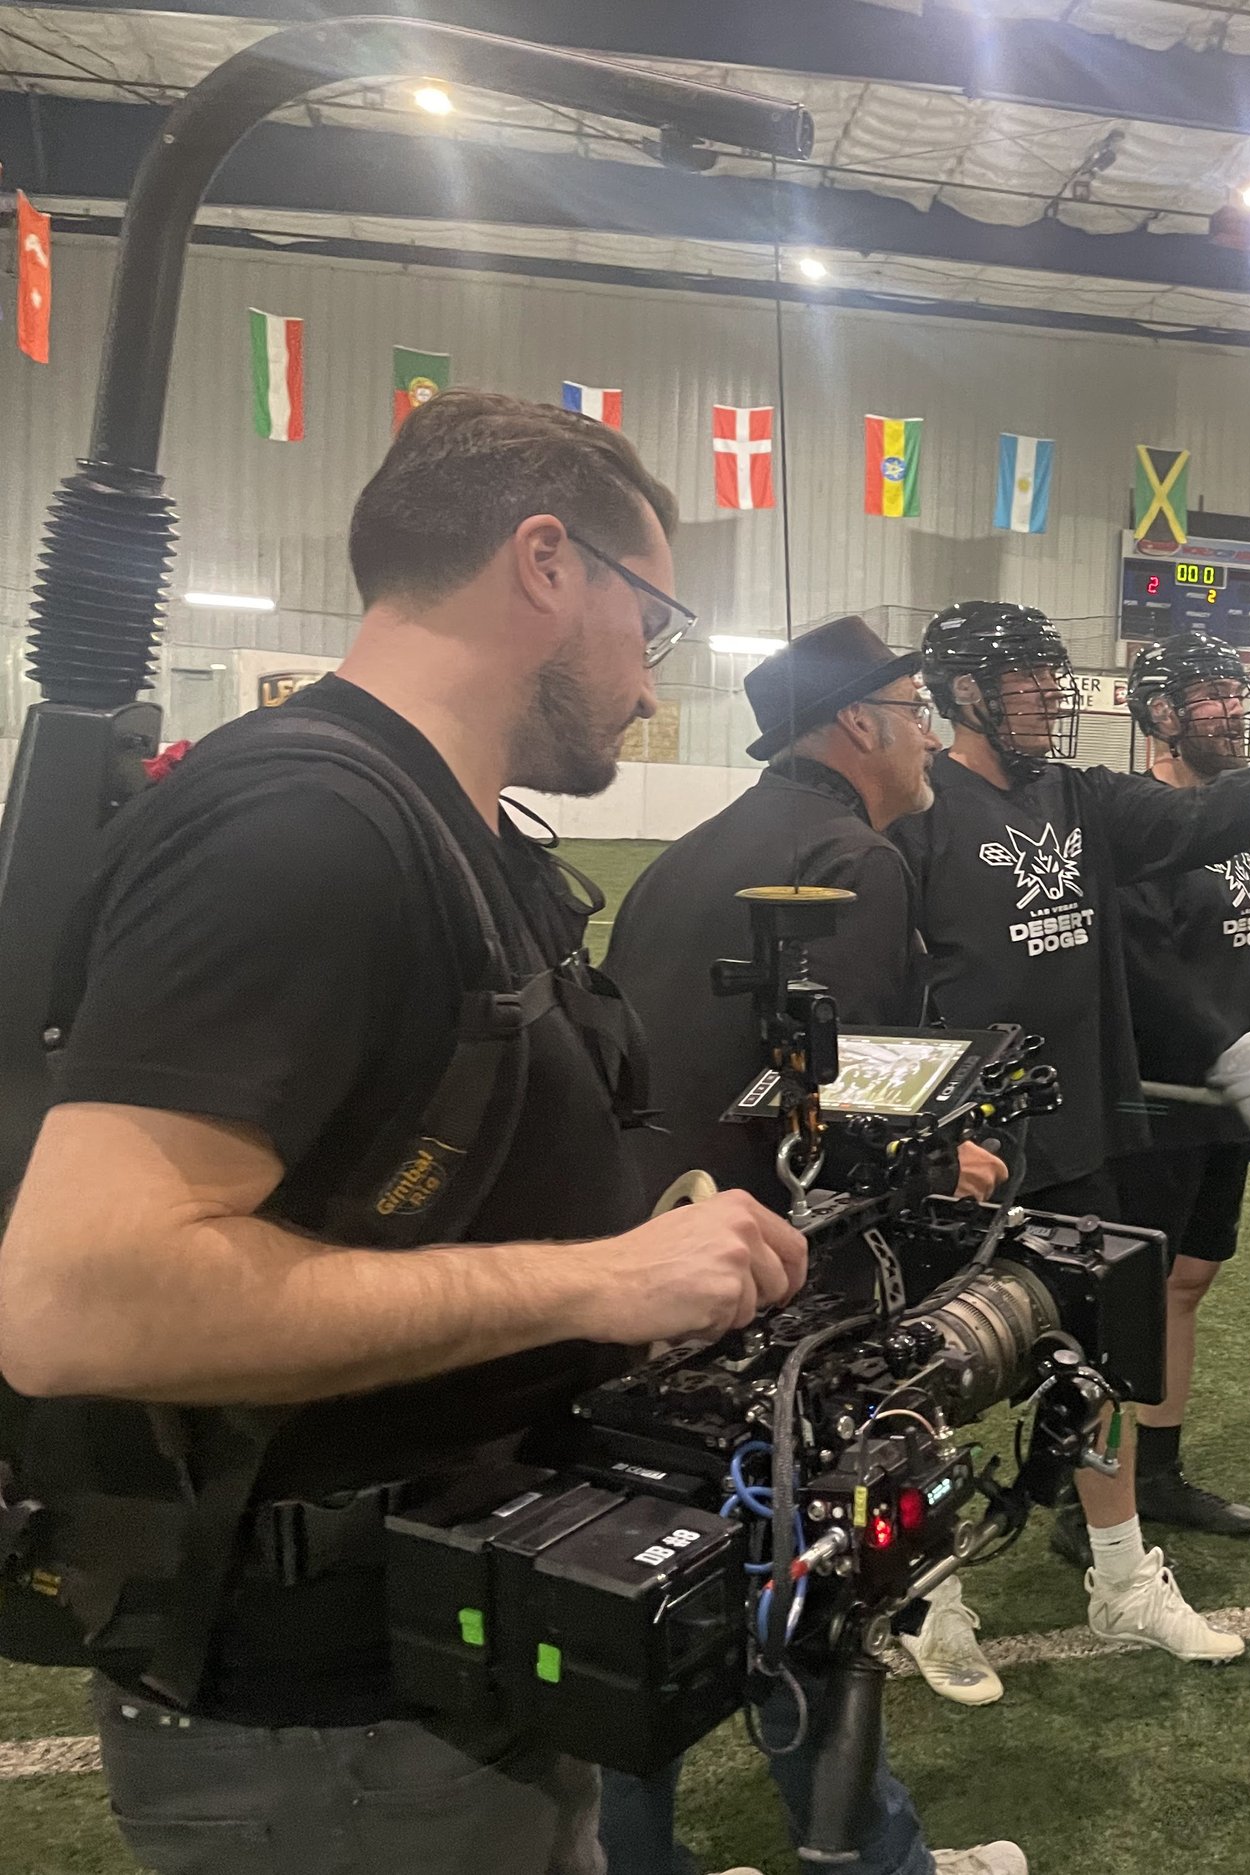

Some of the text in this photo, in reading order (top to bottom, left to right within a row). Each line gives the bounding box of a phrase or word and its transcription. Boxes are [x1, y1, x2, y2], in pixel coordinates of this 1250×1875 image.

[1147, 576, 1159, 594] 2
[1207, 589, 1216, 603] 2
[1009, 908, 1095, 942] DESERT
[1028, 928, 1089, 957] DOGS
[377, 1150, 434, 1215] Gimbal
[633, 1545, 676, 1566] DB
